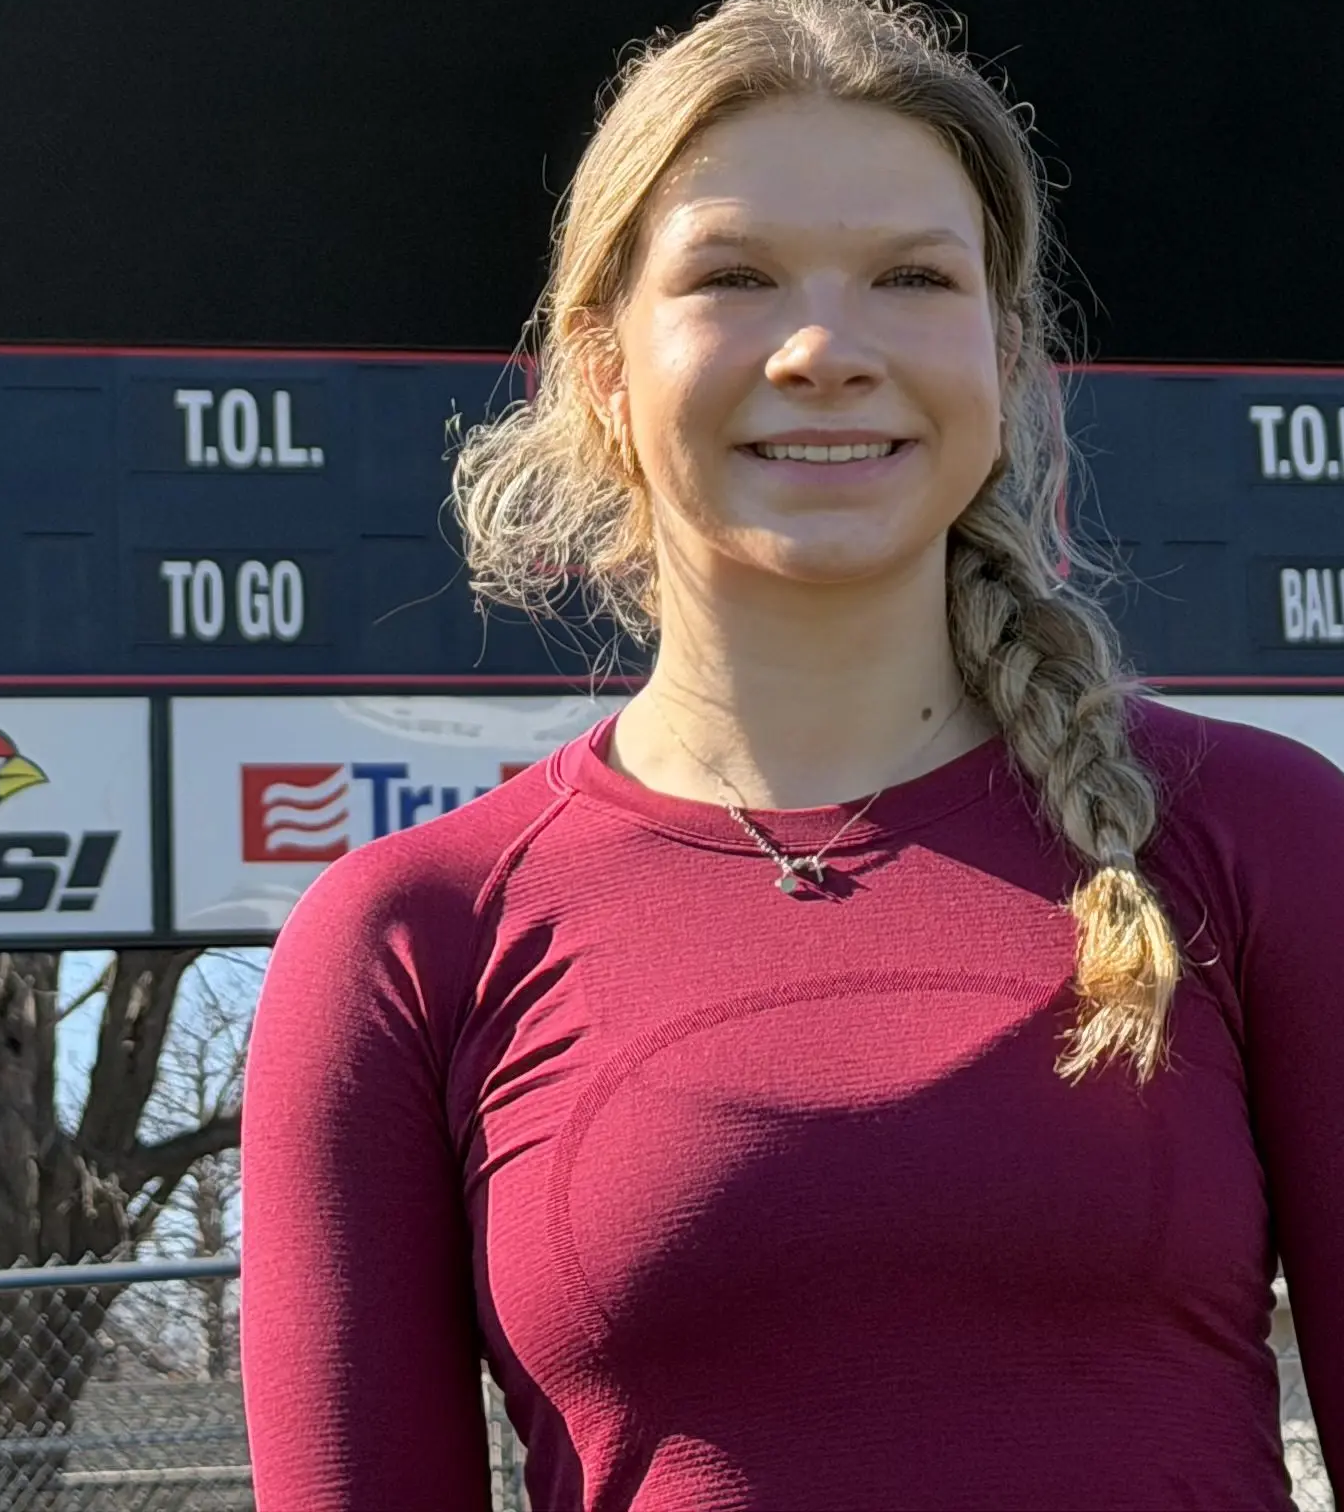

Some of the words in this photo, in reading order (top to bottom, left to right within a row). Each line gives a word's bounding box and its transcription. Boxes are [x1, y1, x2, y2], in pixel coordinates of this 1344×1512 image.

[175, 388, 324, 467] T.O.L.
[160, 560, 225, 640] TO
[236, 560, 305, 640] GO
